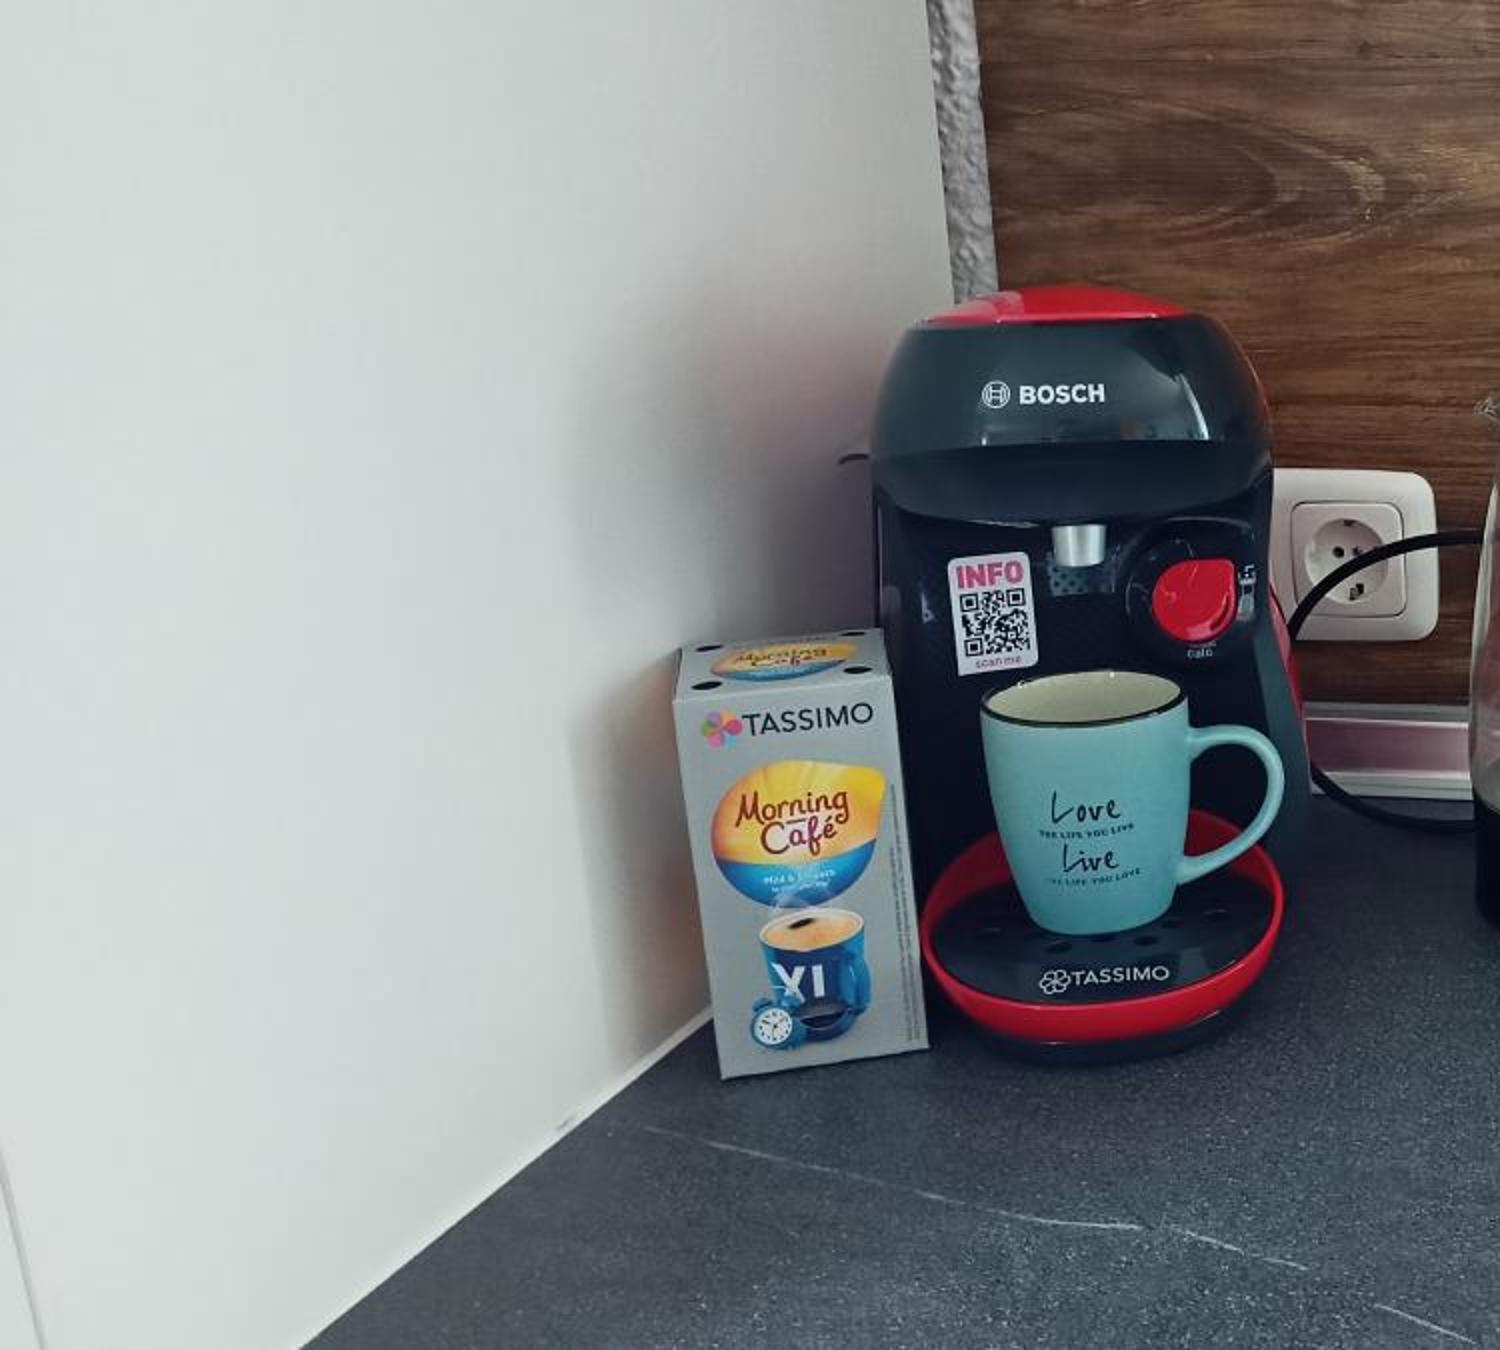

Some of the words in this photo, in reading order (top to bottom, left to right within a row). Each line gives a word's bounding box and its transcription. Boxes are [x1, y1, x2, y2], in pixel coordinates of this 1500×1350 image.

[1019, 383, 1105, 405] BOSCH
[956, 560, 1024, 589] INFO
[741, 702, 874, 737] TASSIMO
[735, 790, 850, 828] Morning
[1051, 790, 1121, 823] Love
[760, 815, 838, 856] Café
[1063, 843, 1120, 872] Live
[1070, 965, 1171, 987] TASSIMO
